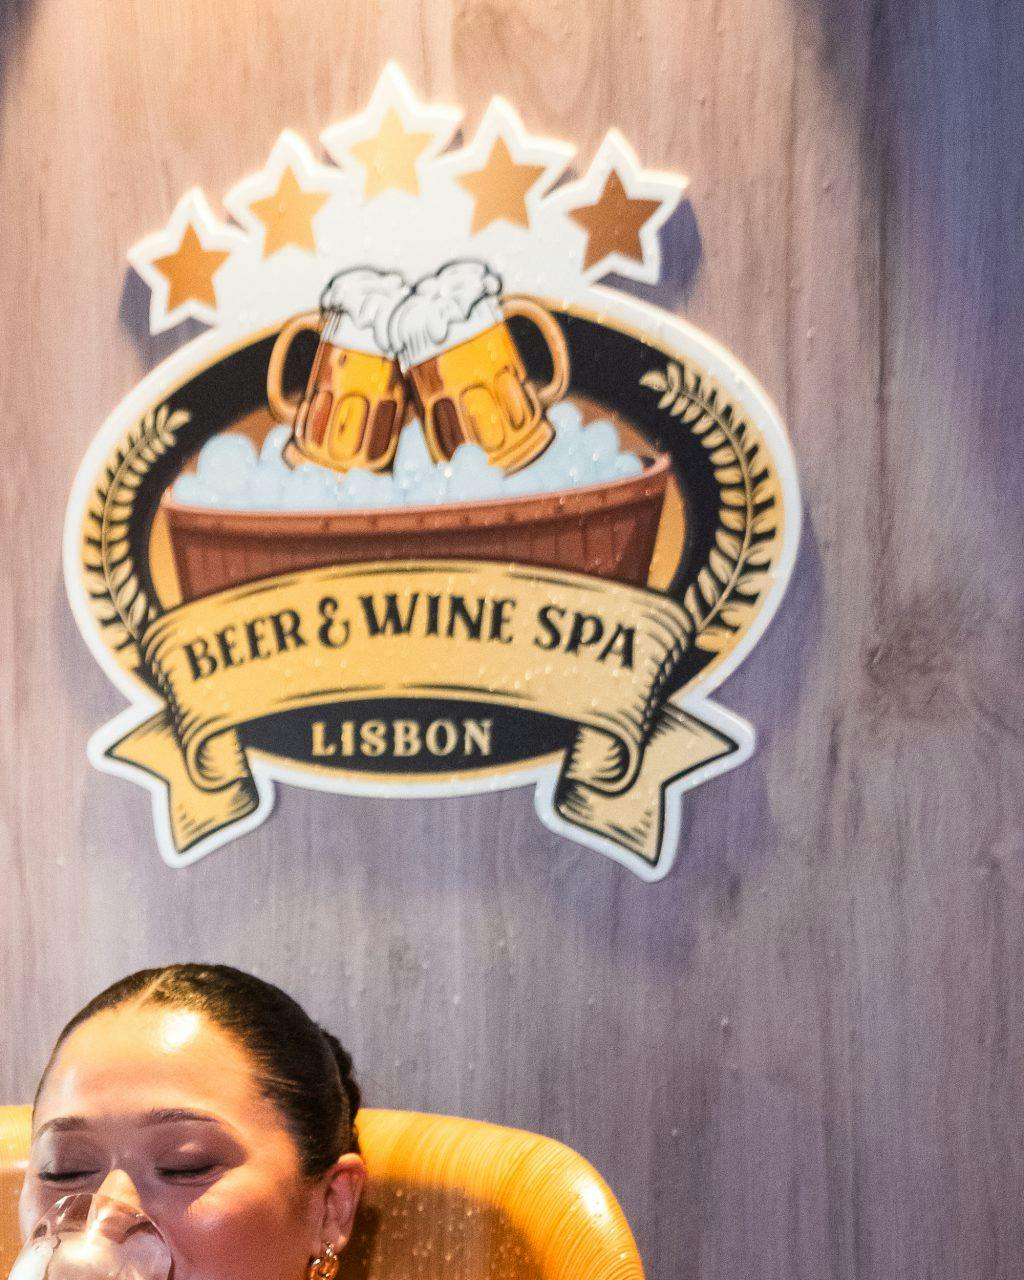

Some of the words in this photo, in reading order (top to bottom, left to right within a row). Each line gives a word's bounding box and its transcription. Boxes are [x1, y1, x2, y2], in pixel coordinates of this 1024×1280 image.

[182, 607, 306, 682] BEER
[318, 596, 351, 650] &
[358, 591, 516, 644] WINE
[533, 603, 636, 668] SPA
[311, 718, 493, 758] LISBON
